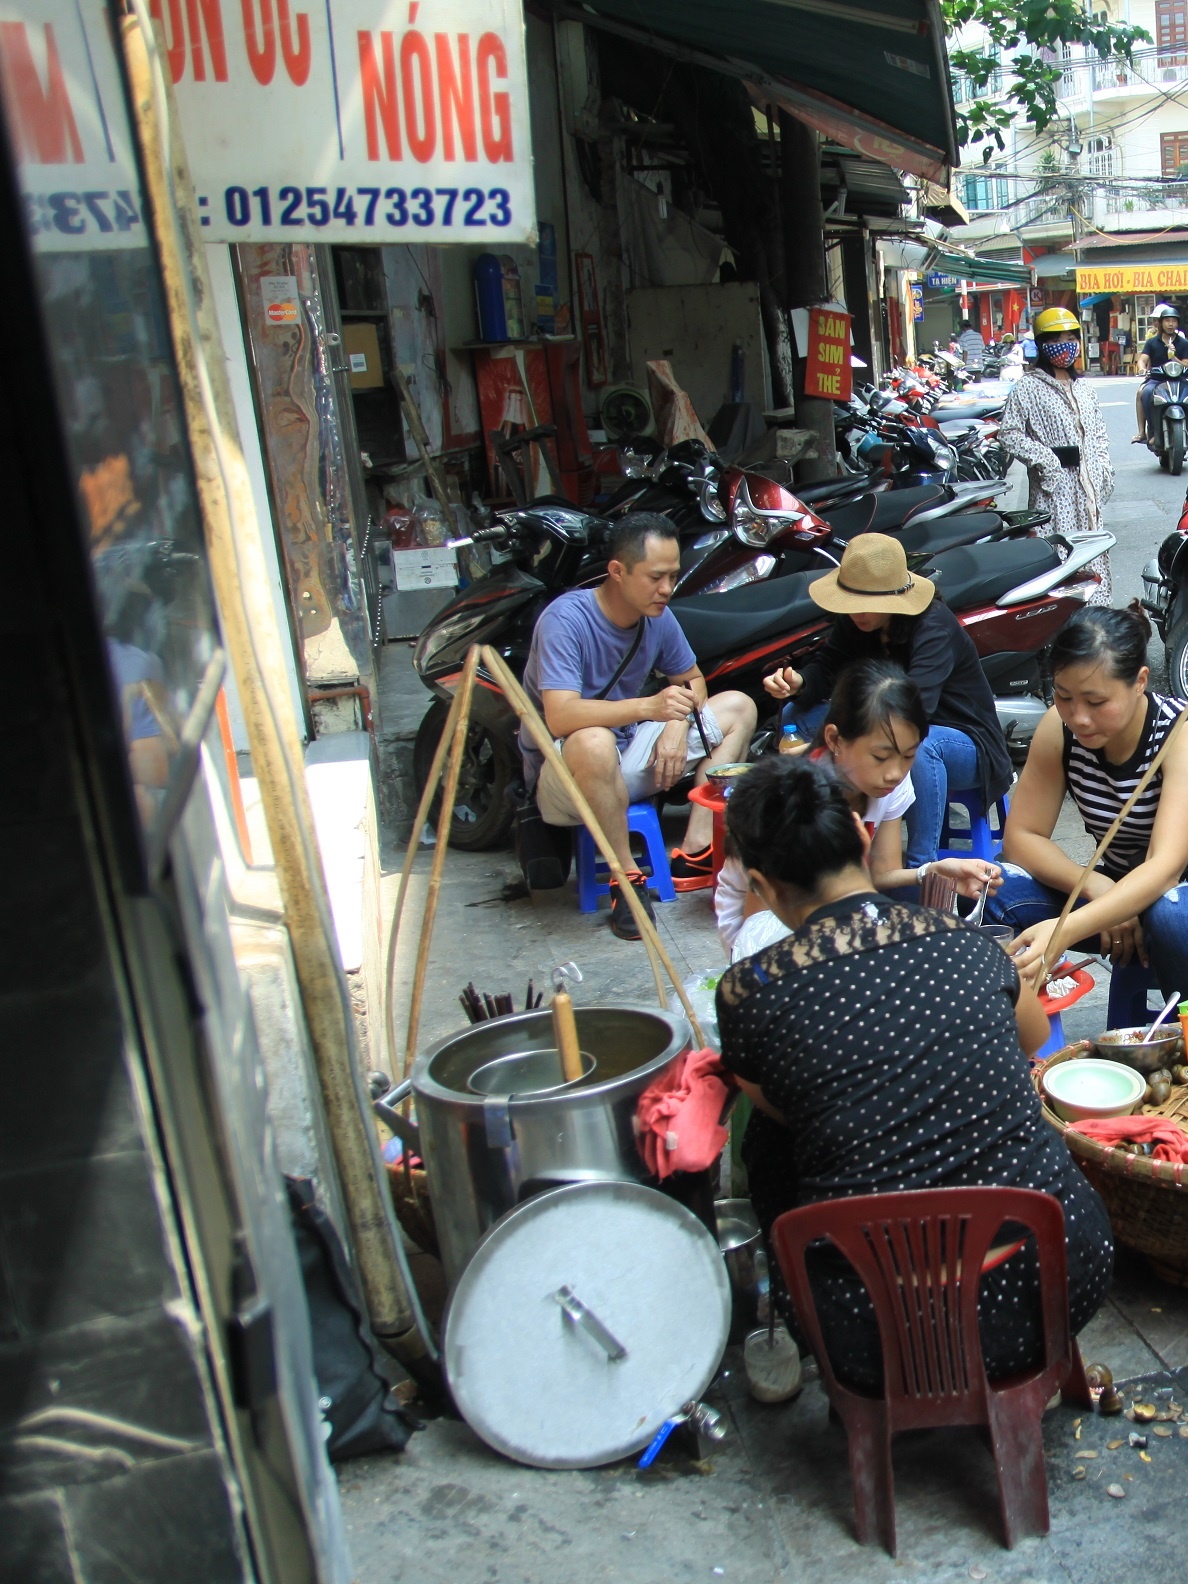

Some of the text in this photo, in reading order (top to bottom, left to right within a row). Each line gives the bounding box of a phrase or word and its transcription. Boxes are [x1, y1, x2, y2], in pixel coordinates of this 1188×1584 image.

[357, 1, 514, 164] NÓNG
[224, 186, 512, 227] 01254733723
[1079, 274, 1100, 290] BIA
[1133, 271, 1154, 288] BIA
[1157, 270, 1188, 287] CHAI
[817, 314, 846, 339] BÁN
[818, 343, 844, 365] SIM
[817, 367, 841, 395] THẺ
